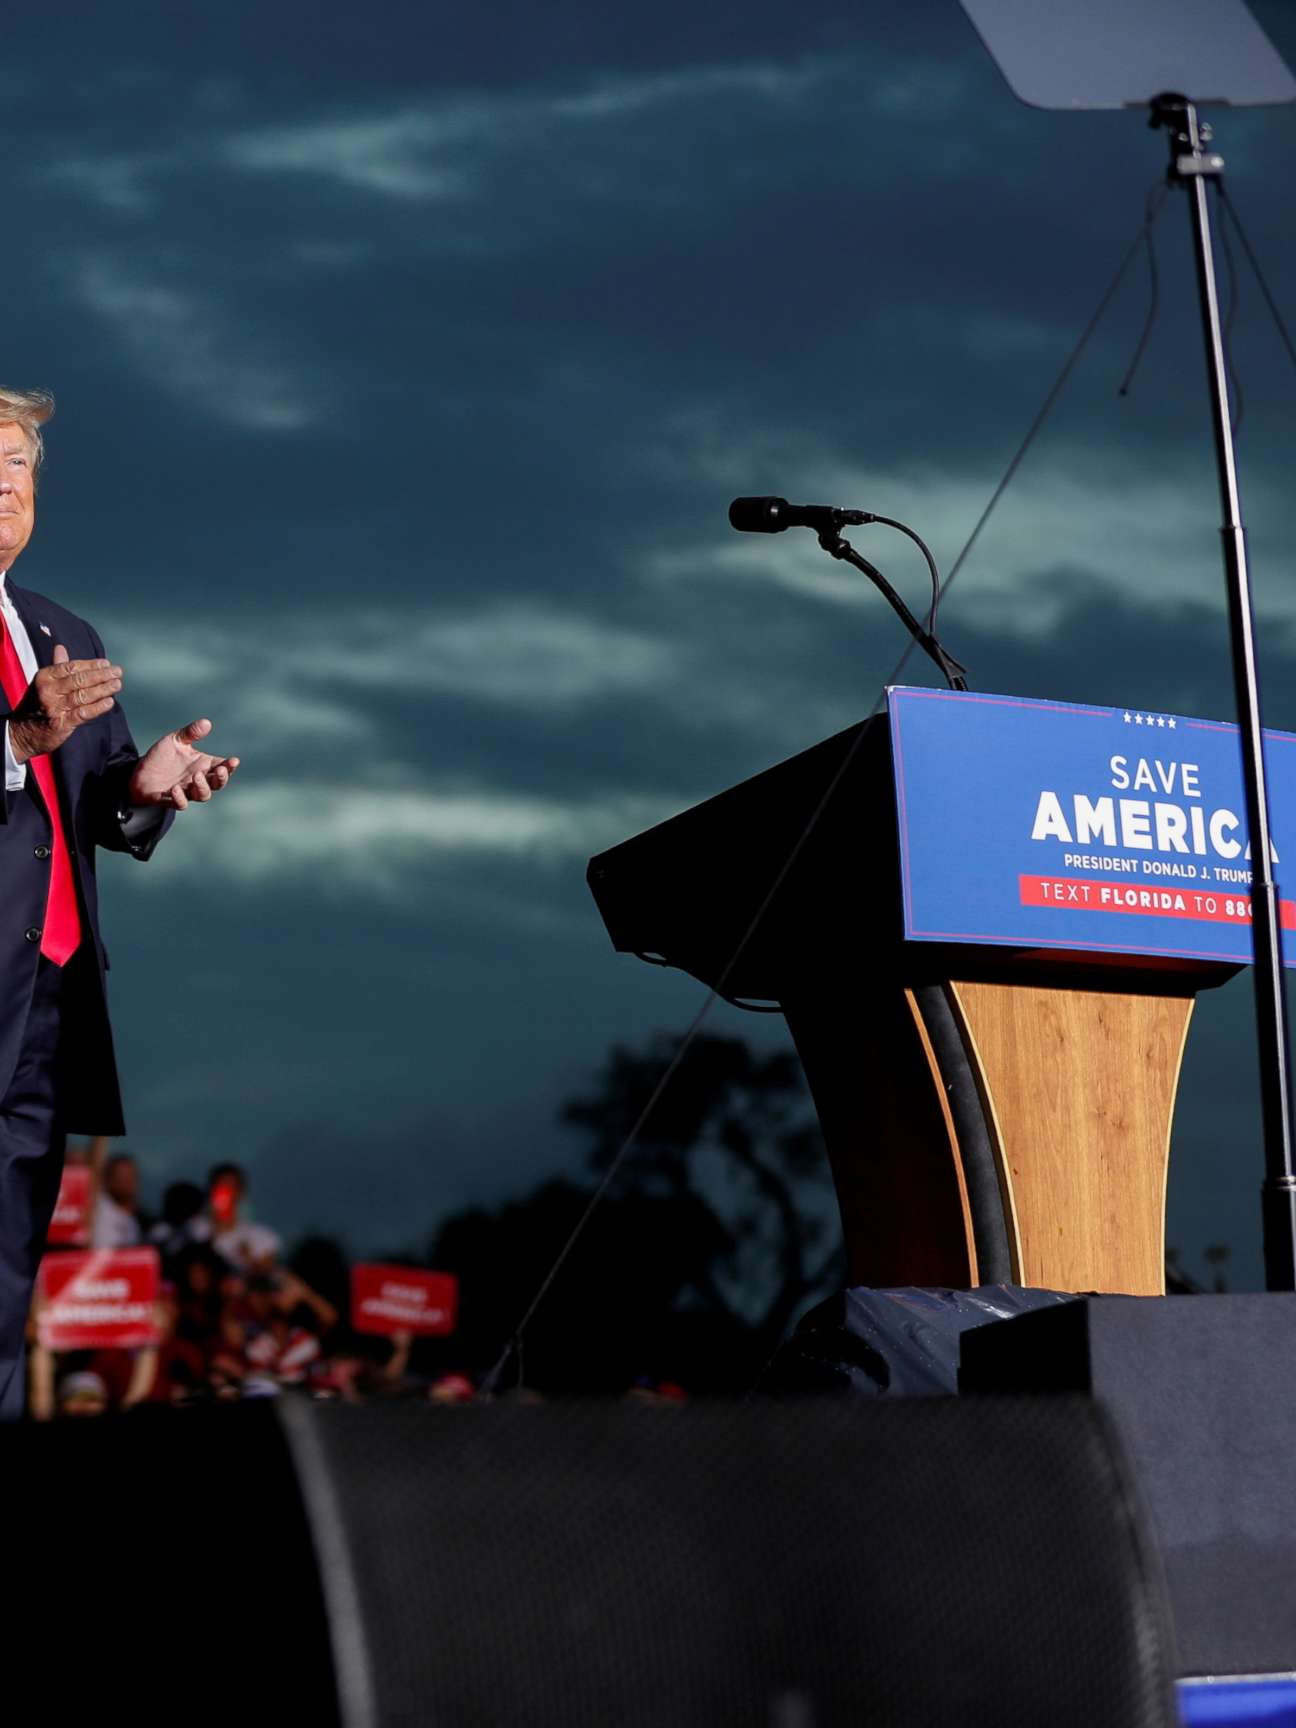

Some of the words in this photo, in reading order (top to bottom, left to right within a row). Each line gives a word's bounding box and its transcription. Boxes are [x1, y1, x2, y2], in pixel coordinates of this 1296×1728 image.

[1109, 755, 1202, 798] SAVE
[1064, 853, 1139, 873] PRESIDENT
[1143, 860, 1197, 879] DONALD
[1200, 866, 1211, 880] J.
[1040, 882, 1091, 902] TEXT
[1100, 887, 1187, 912] FLORIDA
[1193, 896, 1217, 914] TO
